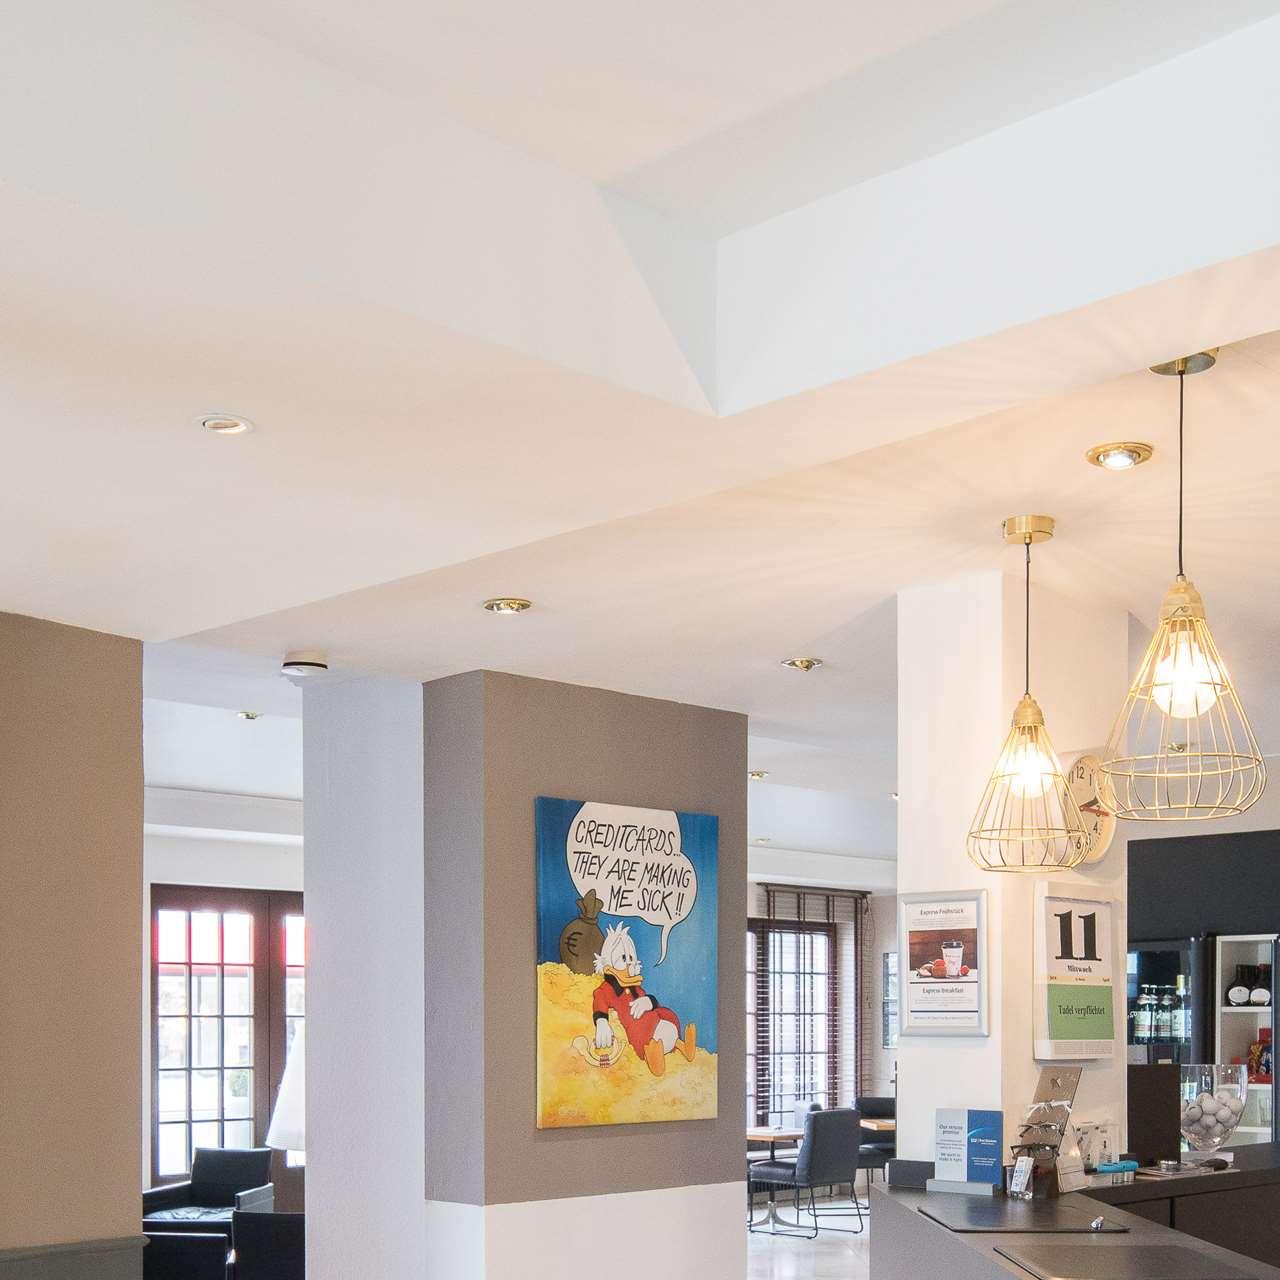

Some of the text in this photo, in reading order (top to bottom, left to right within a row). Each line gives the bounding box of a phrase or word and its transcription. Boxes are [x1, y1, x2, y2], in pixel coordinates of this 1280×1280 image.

[573, 851, 692, 888] THEY ARE MAKING
[608, 885, 633, 912] ME
[1053, 909, 1102, 961] 11
[1075, 1005, 1105, 1017] verpflichtet
